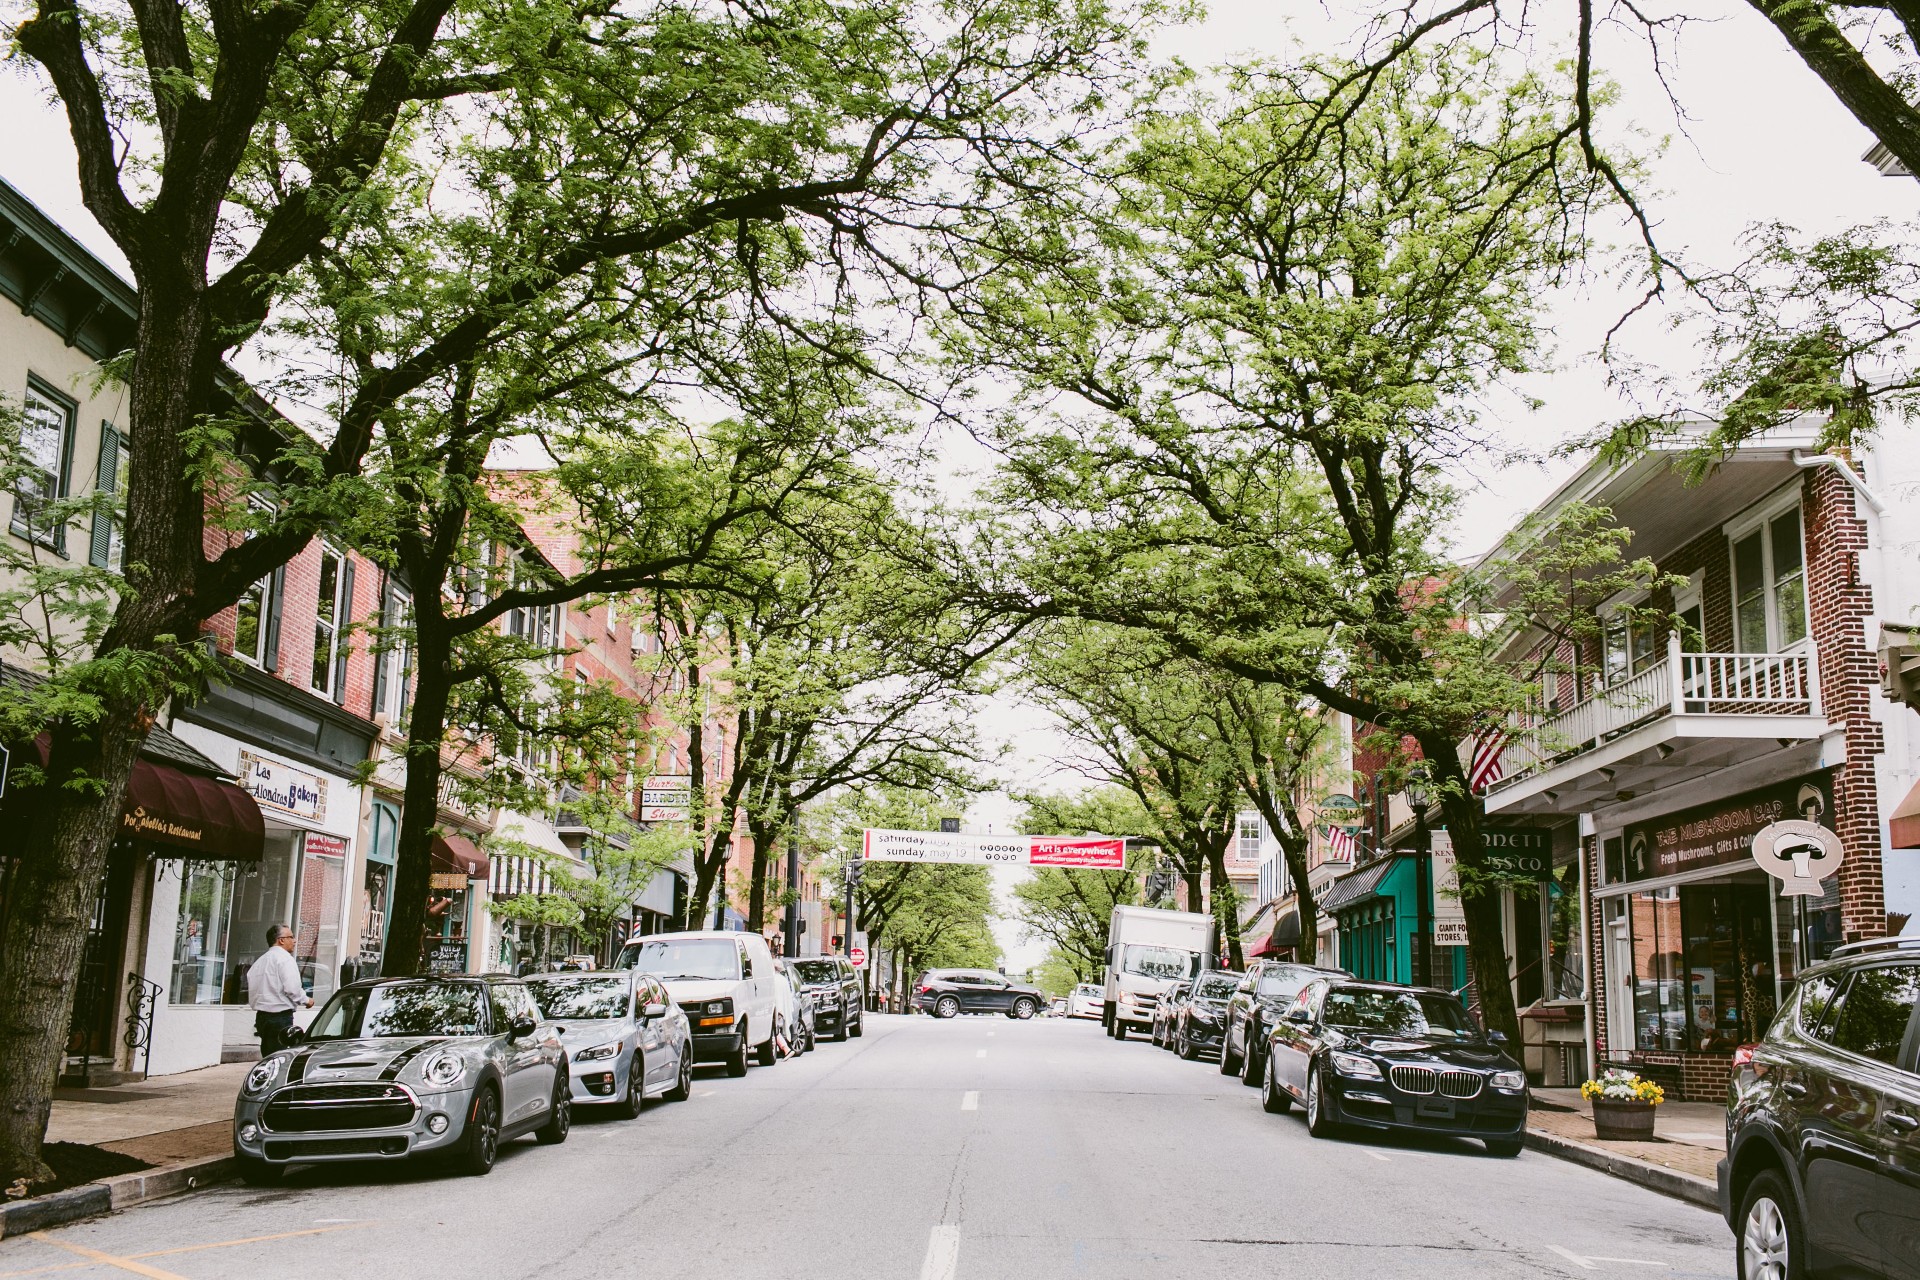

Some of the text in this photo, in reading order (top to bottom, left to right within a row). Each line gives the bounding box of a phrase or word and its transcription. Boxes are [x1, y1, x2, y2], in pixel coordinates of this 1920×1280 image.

[256, 761, 271, 780] Las
[253, 783, 288, 806] Alondras
[644, 793, 688, 803] BARBER
[651, 808, 680, 819] Shop
[1656, 801, 1783, 847] THE MUSHROOM CAP
[168, 823, 202, 840] Restaurant
[1766, 825, 1832, 844] MUSHROOM CAP
[879, 834, 928, 846] saturday,
[1481, 833, 1543, 847] NNETT
[886, 847, 967, 860] sunday, may 19
[1038, 844, 1116, 856] Art is everywhere.
[1661, 852, 1678, 865] Fresh
[1678, 845, 1716, 862] Mushrooms,
[1716, 839, 1732, 854] Gifts
[1733, 840, 1739, 850] &
[1438, 924, 1457, 932] GIANT
[1436, 933, 1463, 941] STORES,
